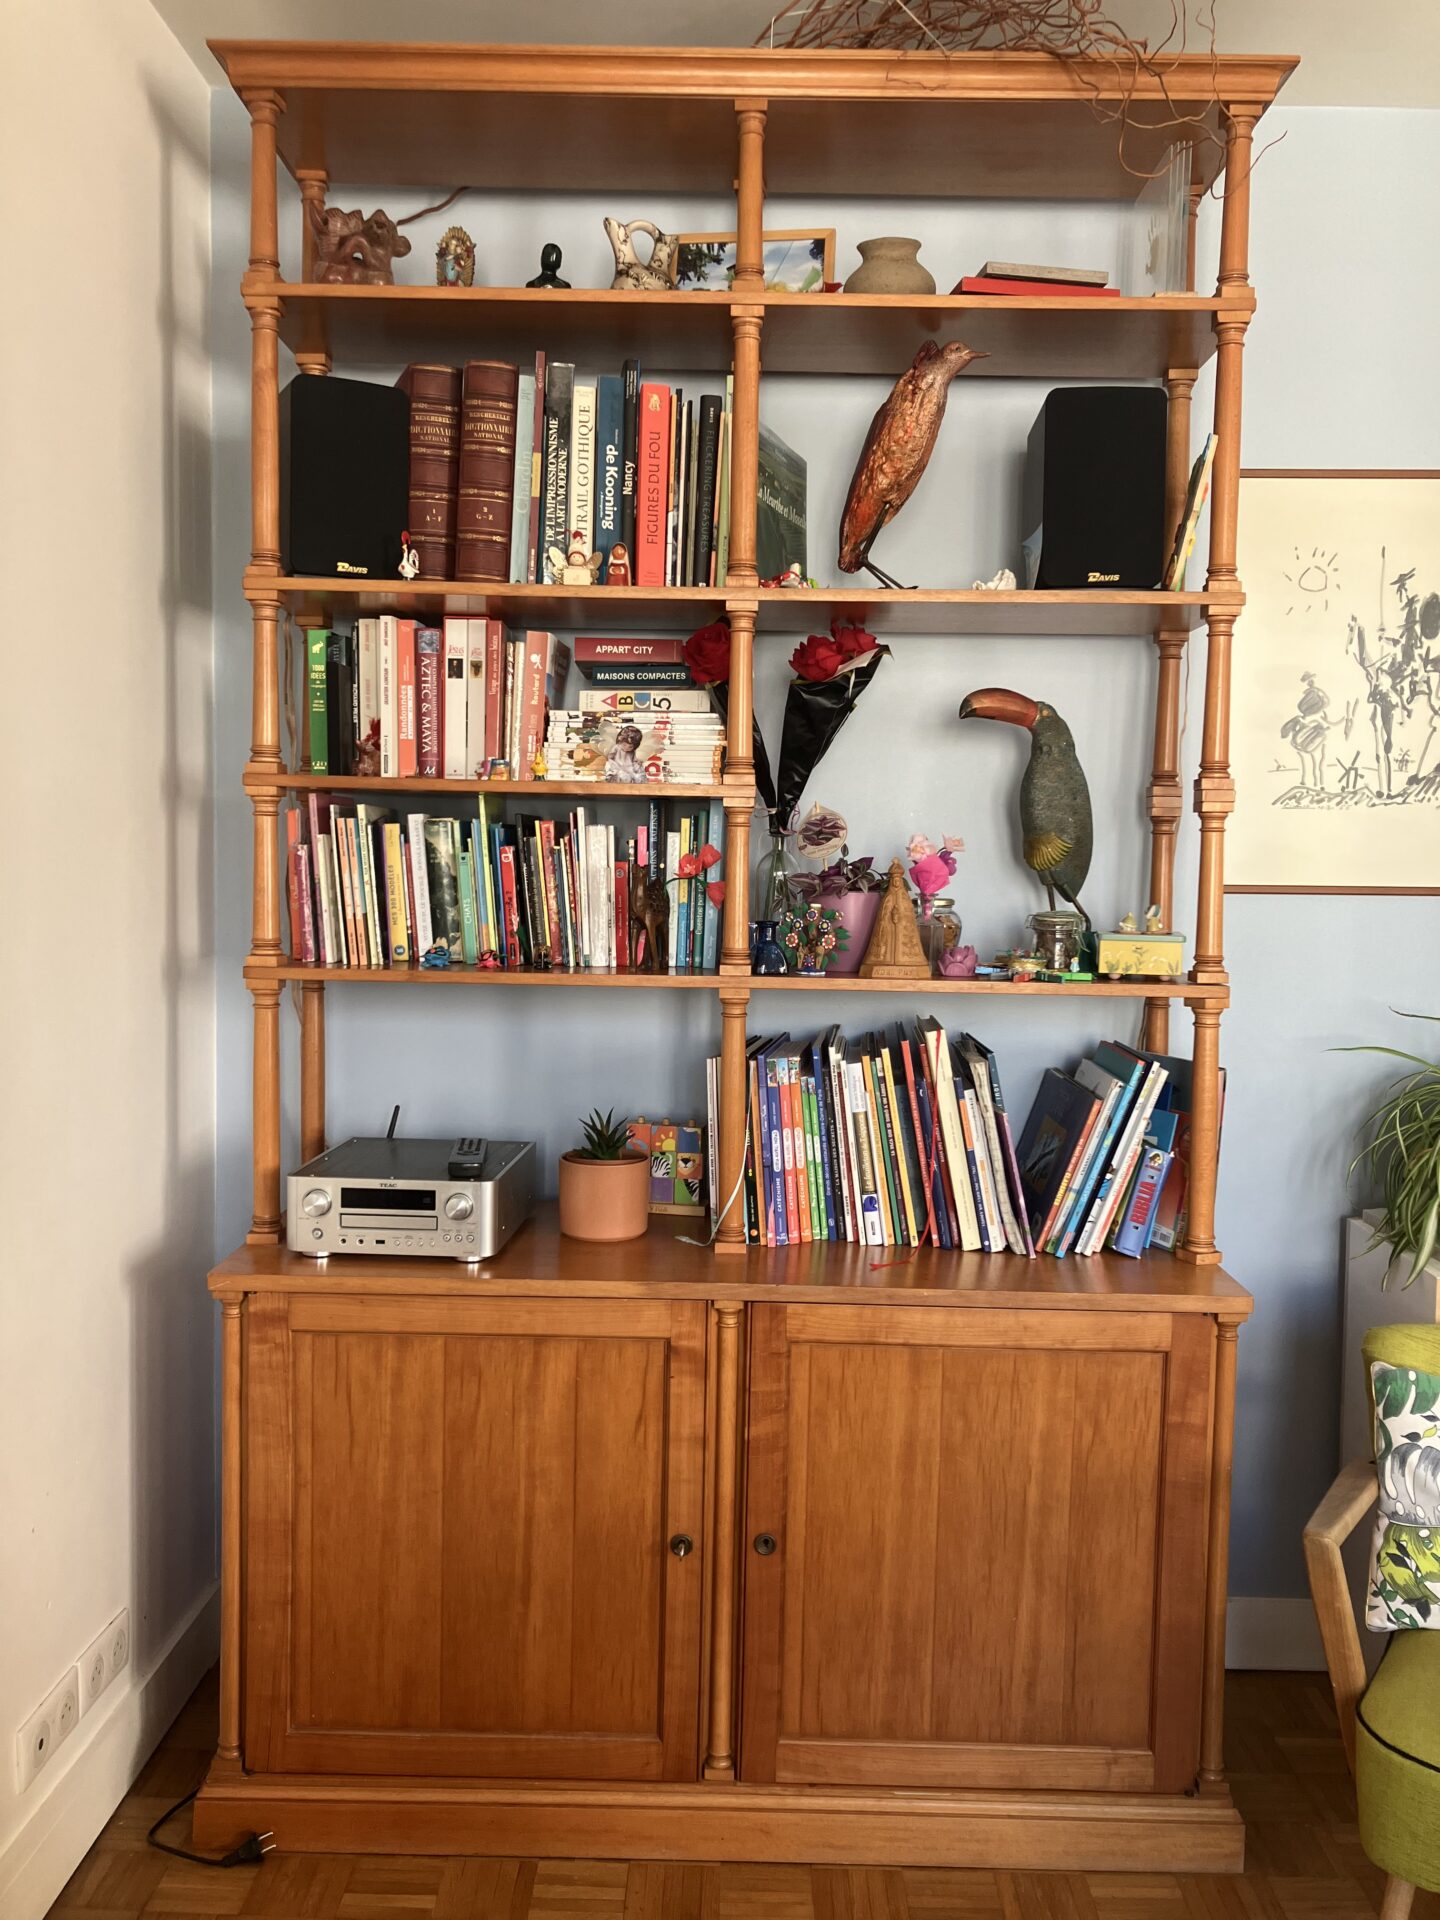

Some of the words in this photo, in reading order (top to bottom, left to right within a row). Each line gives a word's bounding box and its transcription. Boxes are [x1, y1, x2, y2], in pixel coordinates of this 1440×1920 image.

[473, 431, 505, 441] NATIONAL
[576, 404, 593, 487] GOTHIQUE
[648, 431, 661, 459] FOU
[605, 444, 619, 464] de
[702, 429, 715, 491] FLICKERING
[515, 451, 532, 514] Chardin
[557, 447, 568, 501] MODERNE
[622, 460, 636, 496] Nancy
[647, 463, 660, 484] DU
[602, 466, 618, 530] Kooning
[646, 487, 660, 545] FIGURES
[700, 495, 712, 553] TREASURES
[545, 526, 555, 542] DE
[337, 561, 369, 574] DAVIS
[1087, 572, 1121, 583] DAVIS
[632, 646, 654, 655] CITY
[421, 656, 432, 699] AZTEC
[530, 673, 541, 705] Routard
[596, 672, 635, 680] MAISONS
[636, 672, 686, 681] COMPACTES
[400, 684, 408, 740] Randonnées
[421, 702, 432, 713] &
[421, 716, 432, 753] MAYA
[463, 898, 473, 924] CHATS
[862, 1149, 870, 1180] feuilleton
[864, 1180, 871, 1189] Le
[1128, 1181, 1157, 1226] BIBLIA
